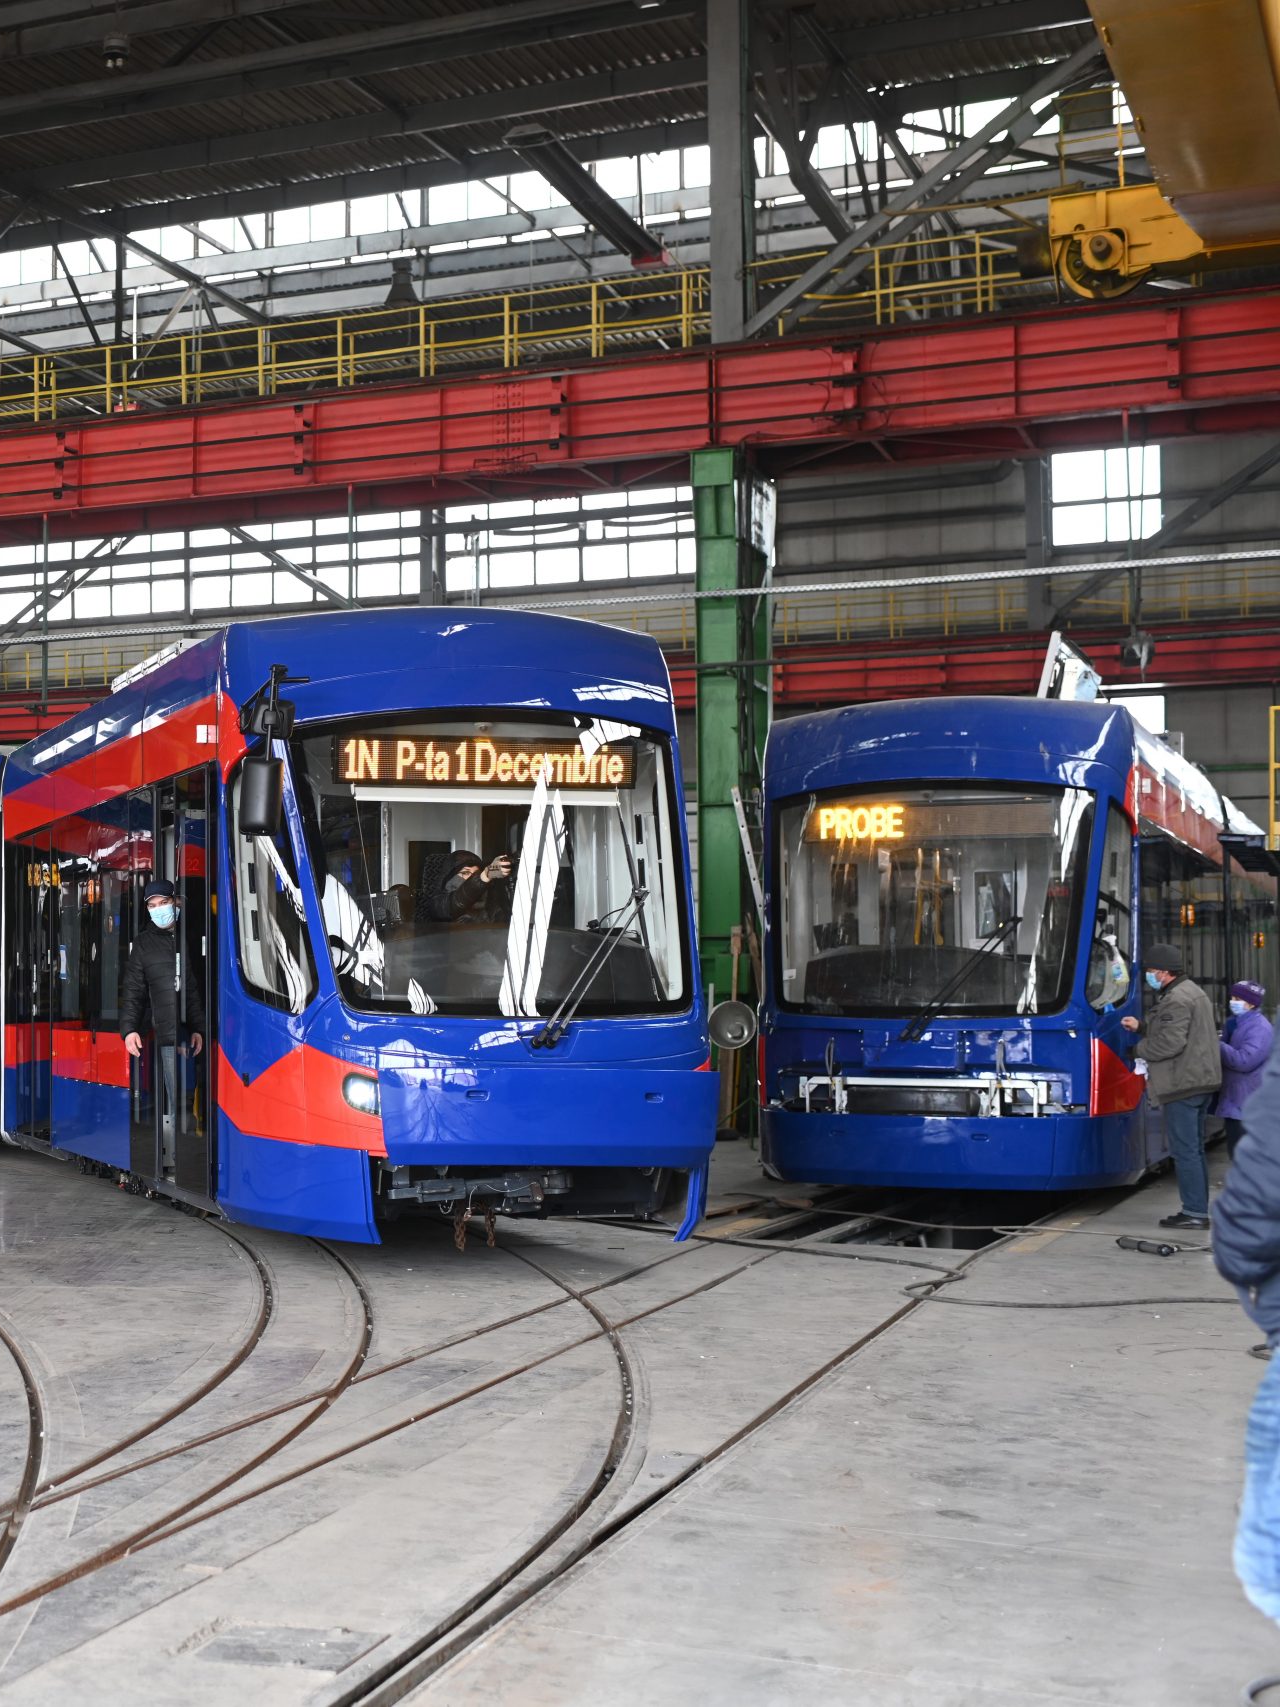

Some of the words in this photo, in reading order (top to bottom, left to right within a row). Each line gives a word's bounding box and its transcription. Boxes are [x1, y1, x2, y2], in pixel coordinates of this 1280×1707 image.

[344, 739, 379, 779] 1N
[396, 740, 450, 781] P-ta
[455, 741, 469, 781] 1
[474, 741, 625, 784] Decembrie
[819, 806, 905, 840] PROBE
